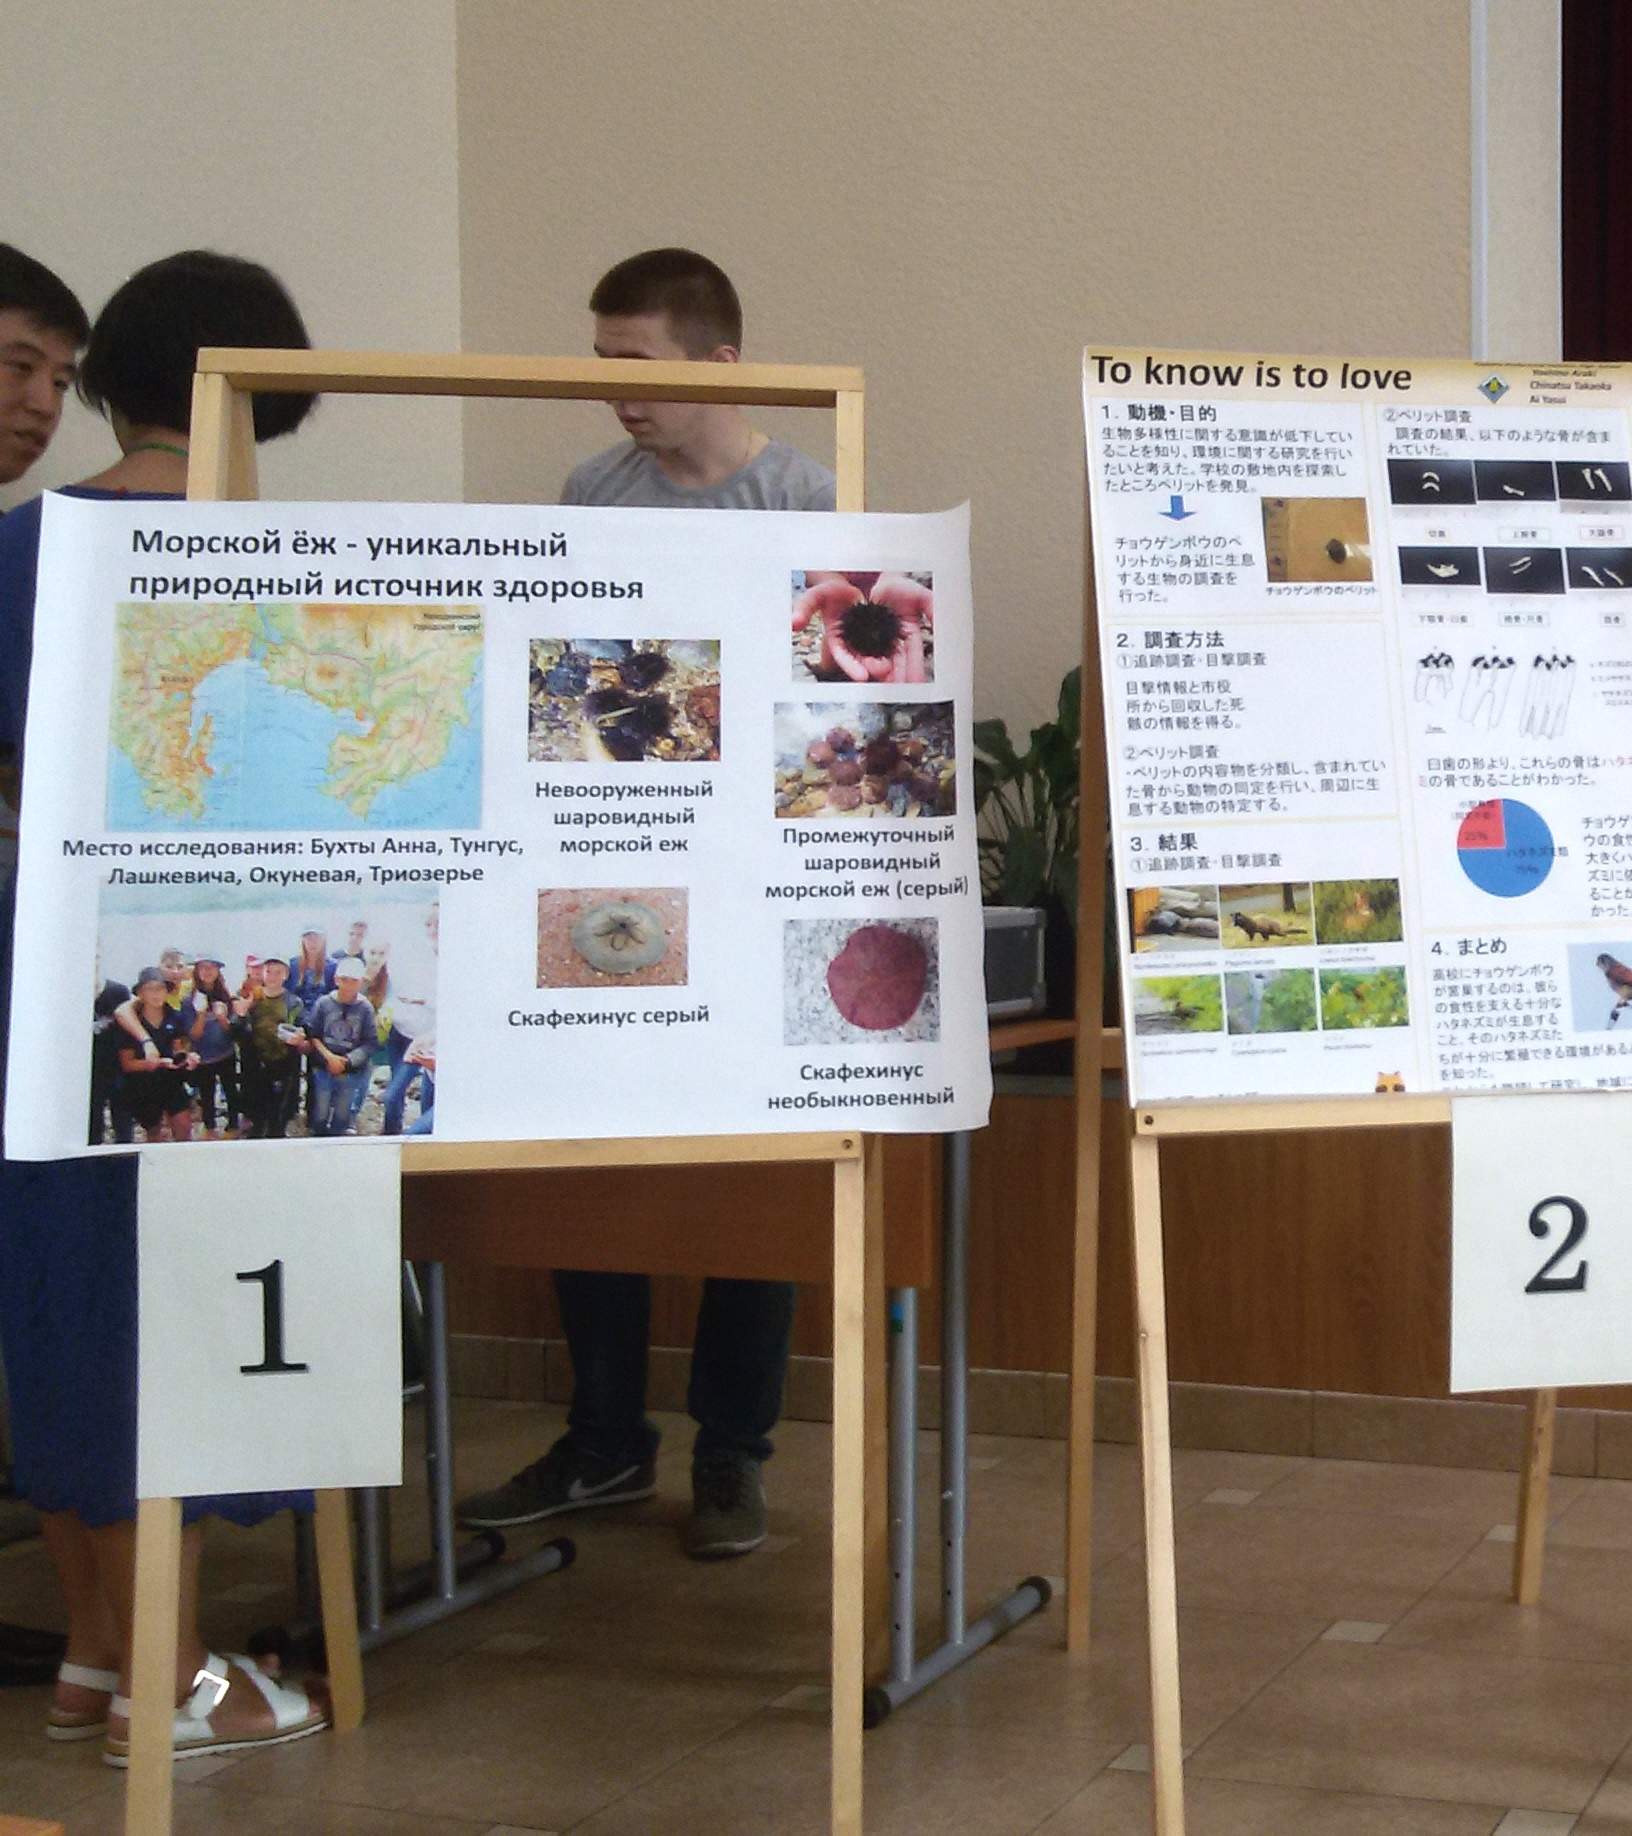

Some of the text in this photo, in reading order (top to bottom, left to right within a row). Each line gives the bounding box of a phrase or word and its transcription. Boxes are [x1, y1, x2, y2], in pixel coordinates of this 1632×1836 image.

[1091, 356, 1412, 390] To know is to love
[131, 529, 282, 557] Морской
[293, 529, 336, 554] ёж
[367, 533, 567, 560] уникальный
[129, 573, 644, 602] природный источник здоровья
[1144, 631, 1225, 649] 調査方法
[535, 781, 713, 801] Невооруженный
[553, 809, 695, 827] шаровидный
[63, 837, 524, 859] Место исследования: Бухты Анна, Тунгус,
[560, 836, 688, 855] морской еж
[783, 827, 955, 848] Промежуточный
[1158, 832, 1199, 851] 結果
[805, 853, 941, 871] шаровидный
[108, 866, 484, 887] Лашкевича, Окуневая, Триозерье
[765, 876, 968, 900] морской еж (серый)
[1457, 937, 1507, 956] まとめ
[508, 1007, 710, 1029] Скафехинус серый
[800, 1064, 924, 1082] Скафехинус
[767, 1088, 955, 1110] необыкновенный
[1525, 1196, 1591, 1294] 2
[235, 1258, 310, 1375] 1
